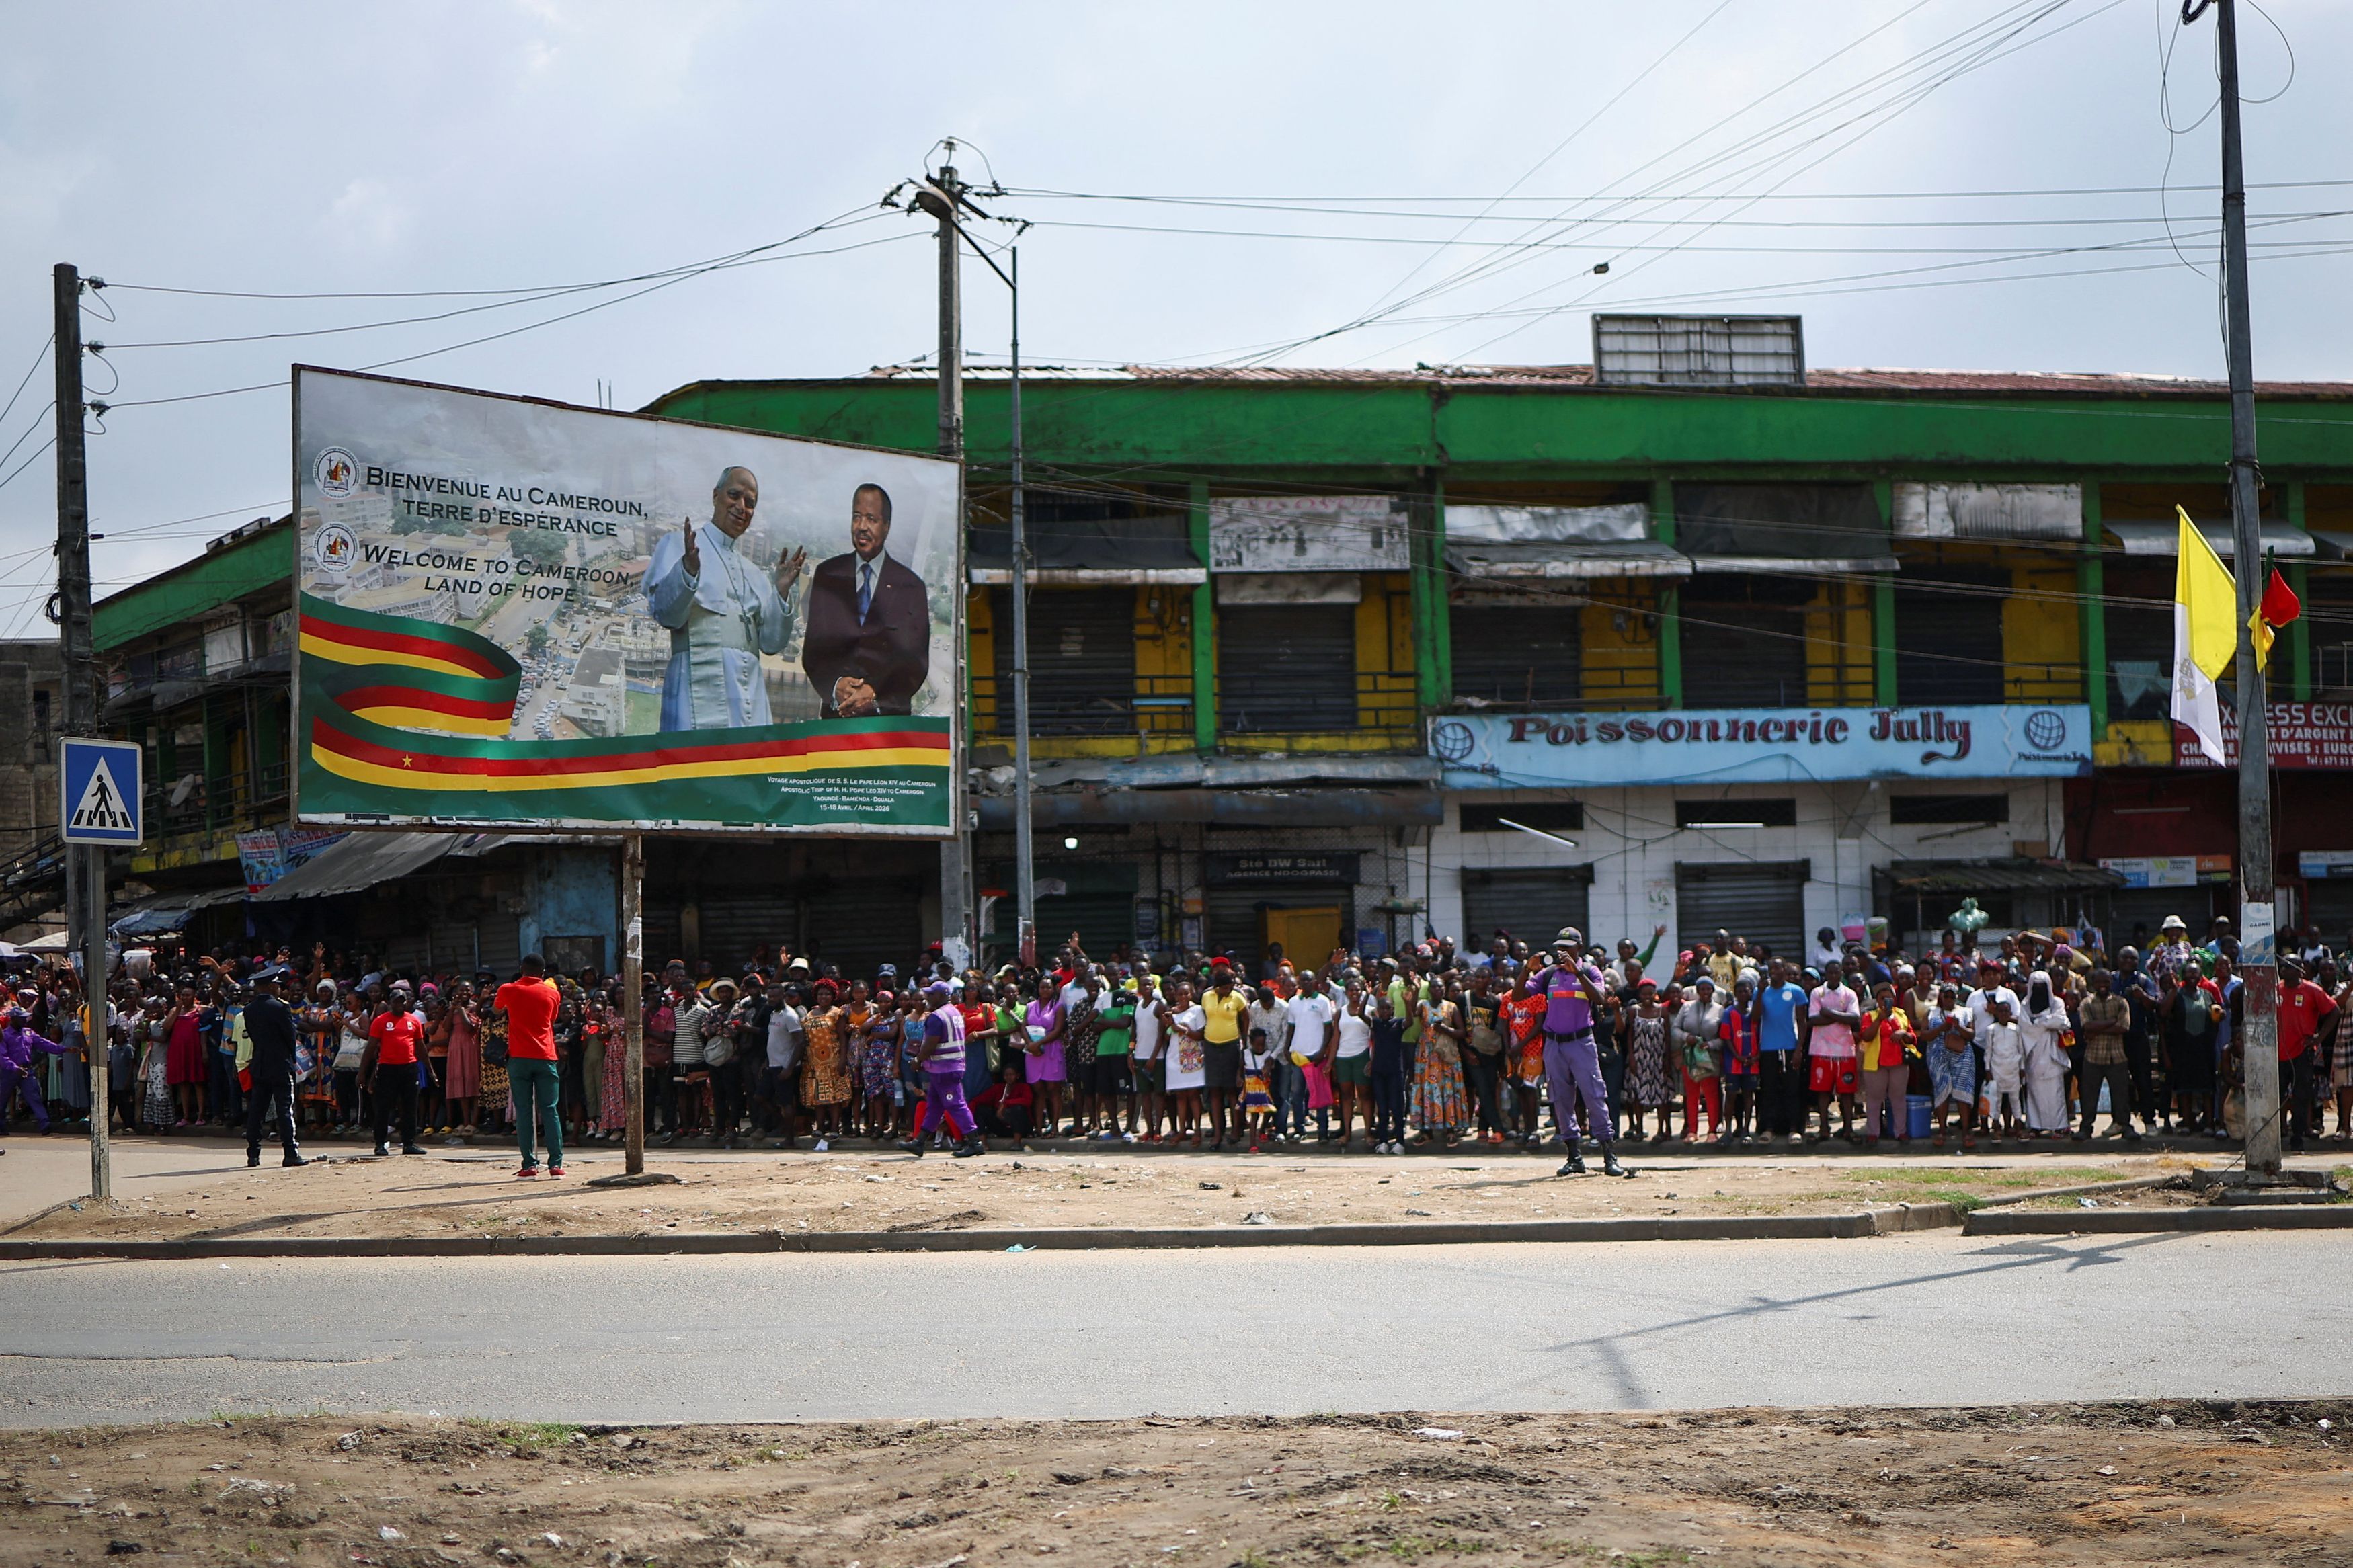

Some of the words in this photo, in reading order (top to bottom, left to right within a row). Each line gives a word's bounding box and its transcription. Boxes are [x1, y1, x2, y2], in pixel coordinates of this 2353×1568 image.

[366, 466, 490, 499] BIENVENUE
[497, 486, 522, 502] AU
[528, 487, 649, 520] CAMEROUN,
[403, 499, 473, 522] TERRE
[364, 544, 477, 571] WELCOME
[484, 559, 510, 574] TO
[515, 559, 634, 586] CAMEROON,
[424, 577, 482, 594] LAND
[489, 582, 514, 597] OF
[522, 585, 576, 602] HOPE
[2311, 704, 2353, 726] EXC
[1507, 710, 1850, 745] Poissonnerie
[1869, 709, 1971, 766] Jully
[2281, 726, 2346, 740] D'ARGENT
[1226, 870, 1271, 878] AGENCE
[1267, 858, 1292, 868] DW
[1297, 858, 1326, 867] Sarl
